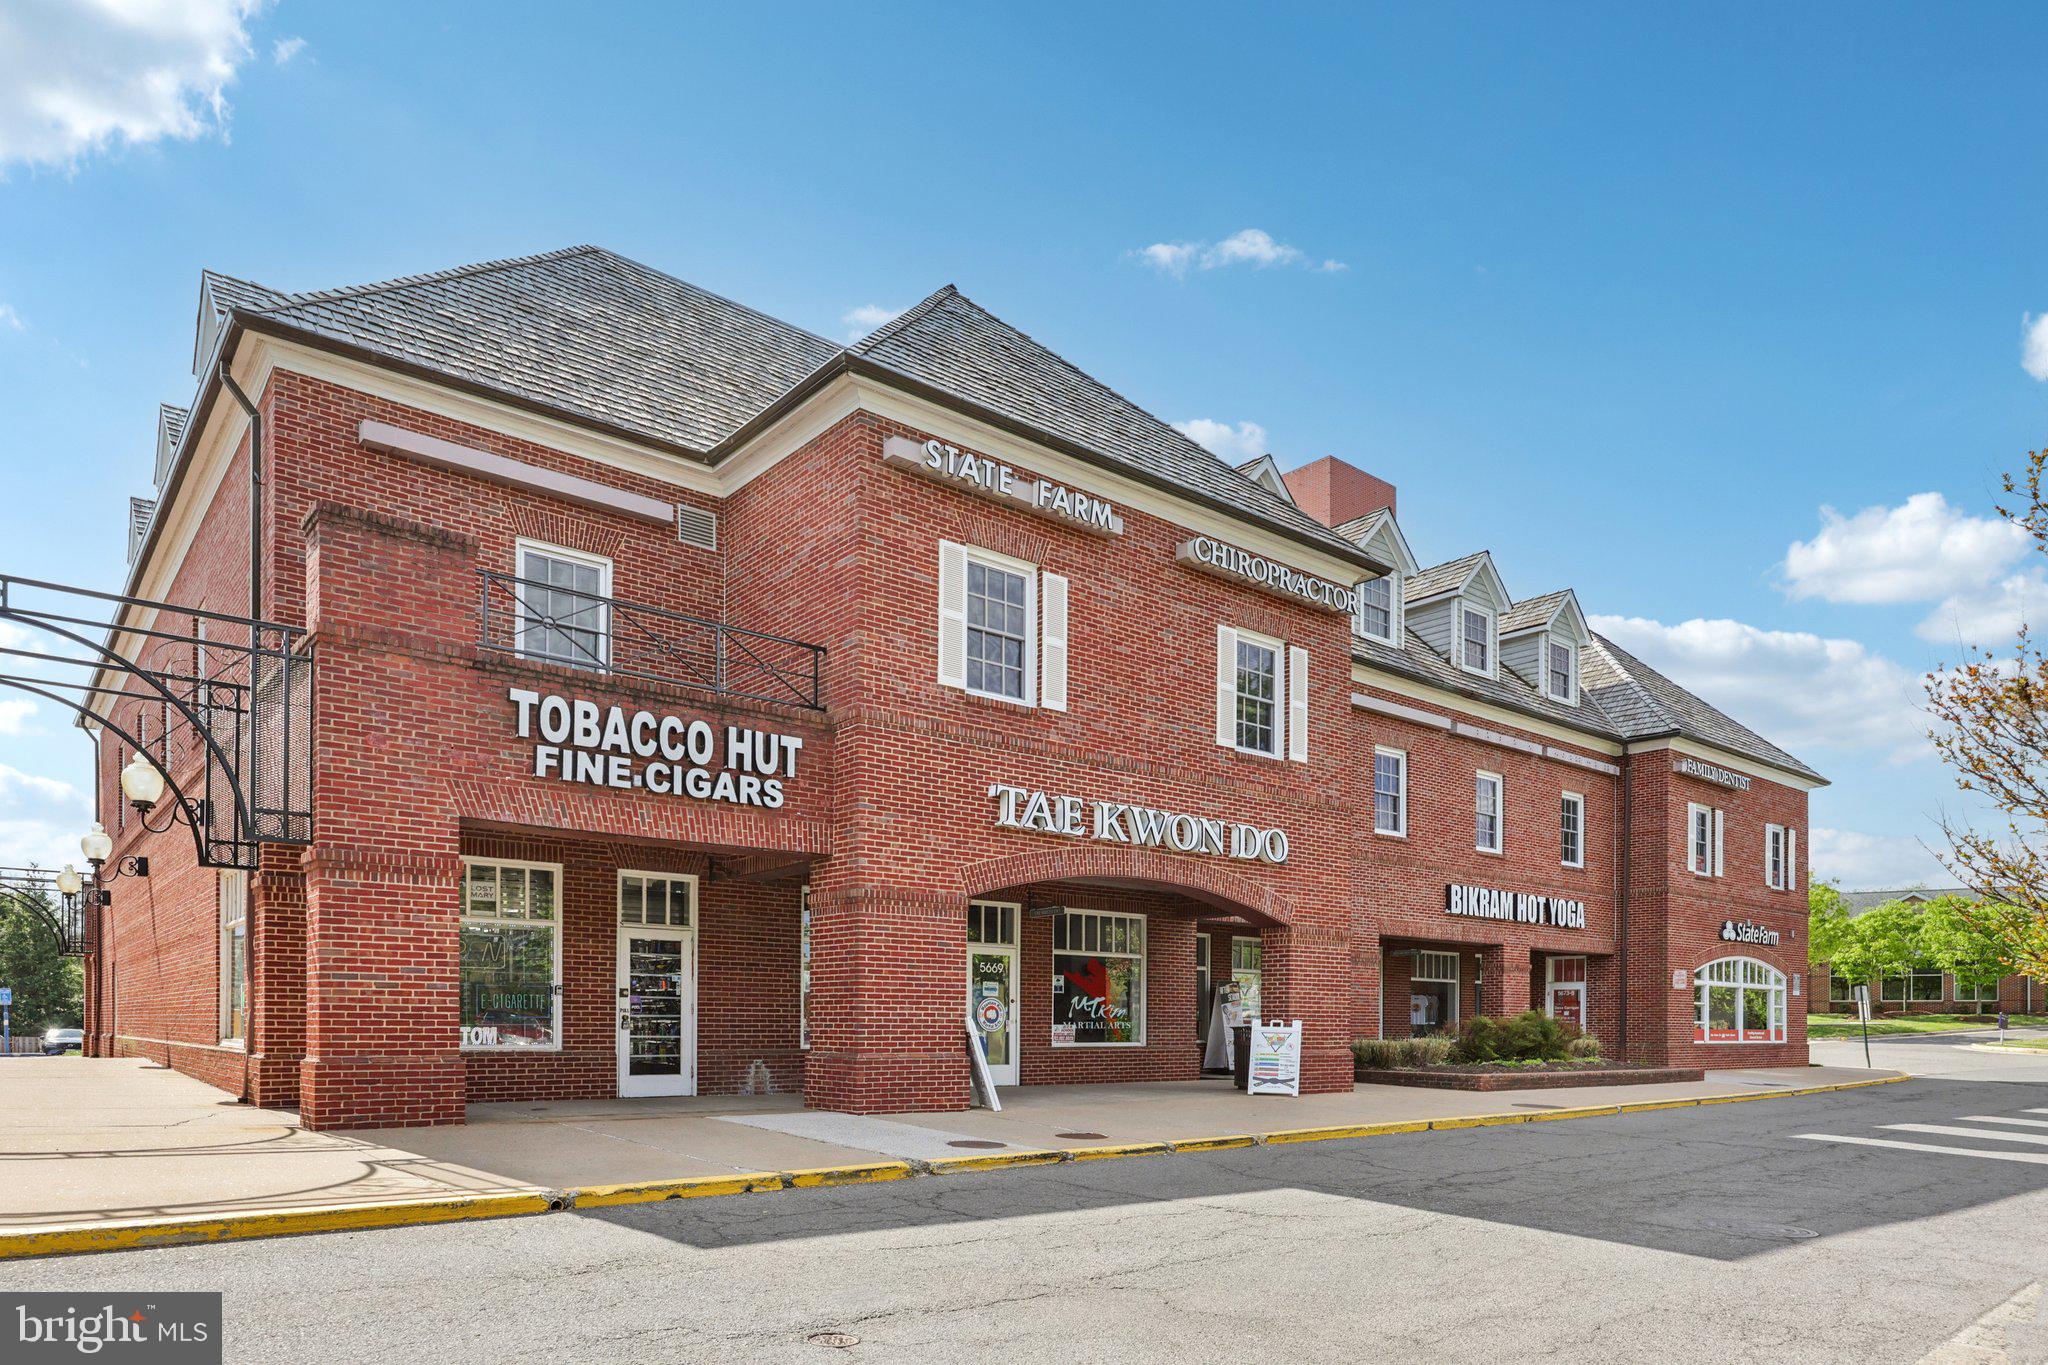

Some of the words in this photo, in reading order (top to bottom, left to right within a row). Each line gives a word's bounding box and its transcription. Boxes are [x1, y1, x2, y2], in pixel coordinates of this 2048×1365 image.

[922, 439, 1014, 495] STATE
[1032, 479, 1114, 530] FARM
[1192, 536, 1359, 615] CHIROPRACTOR
[508, 687, 714, 766] TOBACCO
[724, 726, 803, 778] HUT
[1685, 758, 1717, 780] FAMILY
[1717, 768, 1751, 791] DENTIST
[988, 783, 1085, 837] TAE
[1090, 800, 1226, 856] KWON
[1228, 823, 1289, 864] DO
[1448, 884, 1514, 921] BIKRAM
[1517, 893, 1546, 925] HOT
[1549, 898, 1586, 929] YOGA
[979, 962, 1004, 973] 5669
[481, 993, 546, 1010] E-CIGARETTE
[1062, 1021, 1106, 1029] MARTIAL
[1107, 1021, 1132, 1029] ARTS
